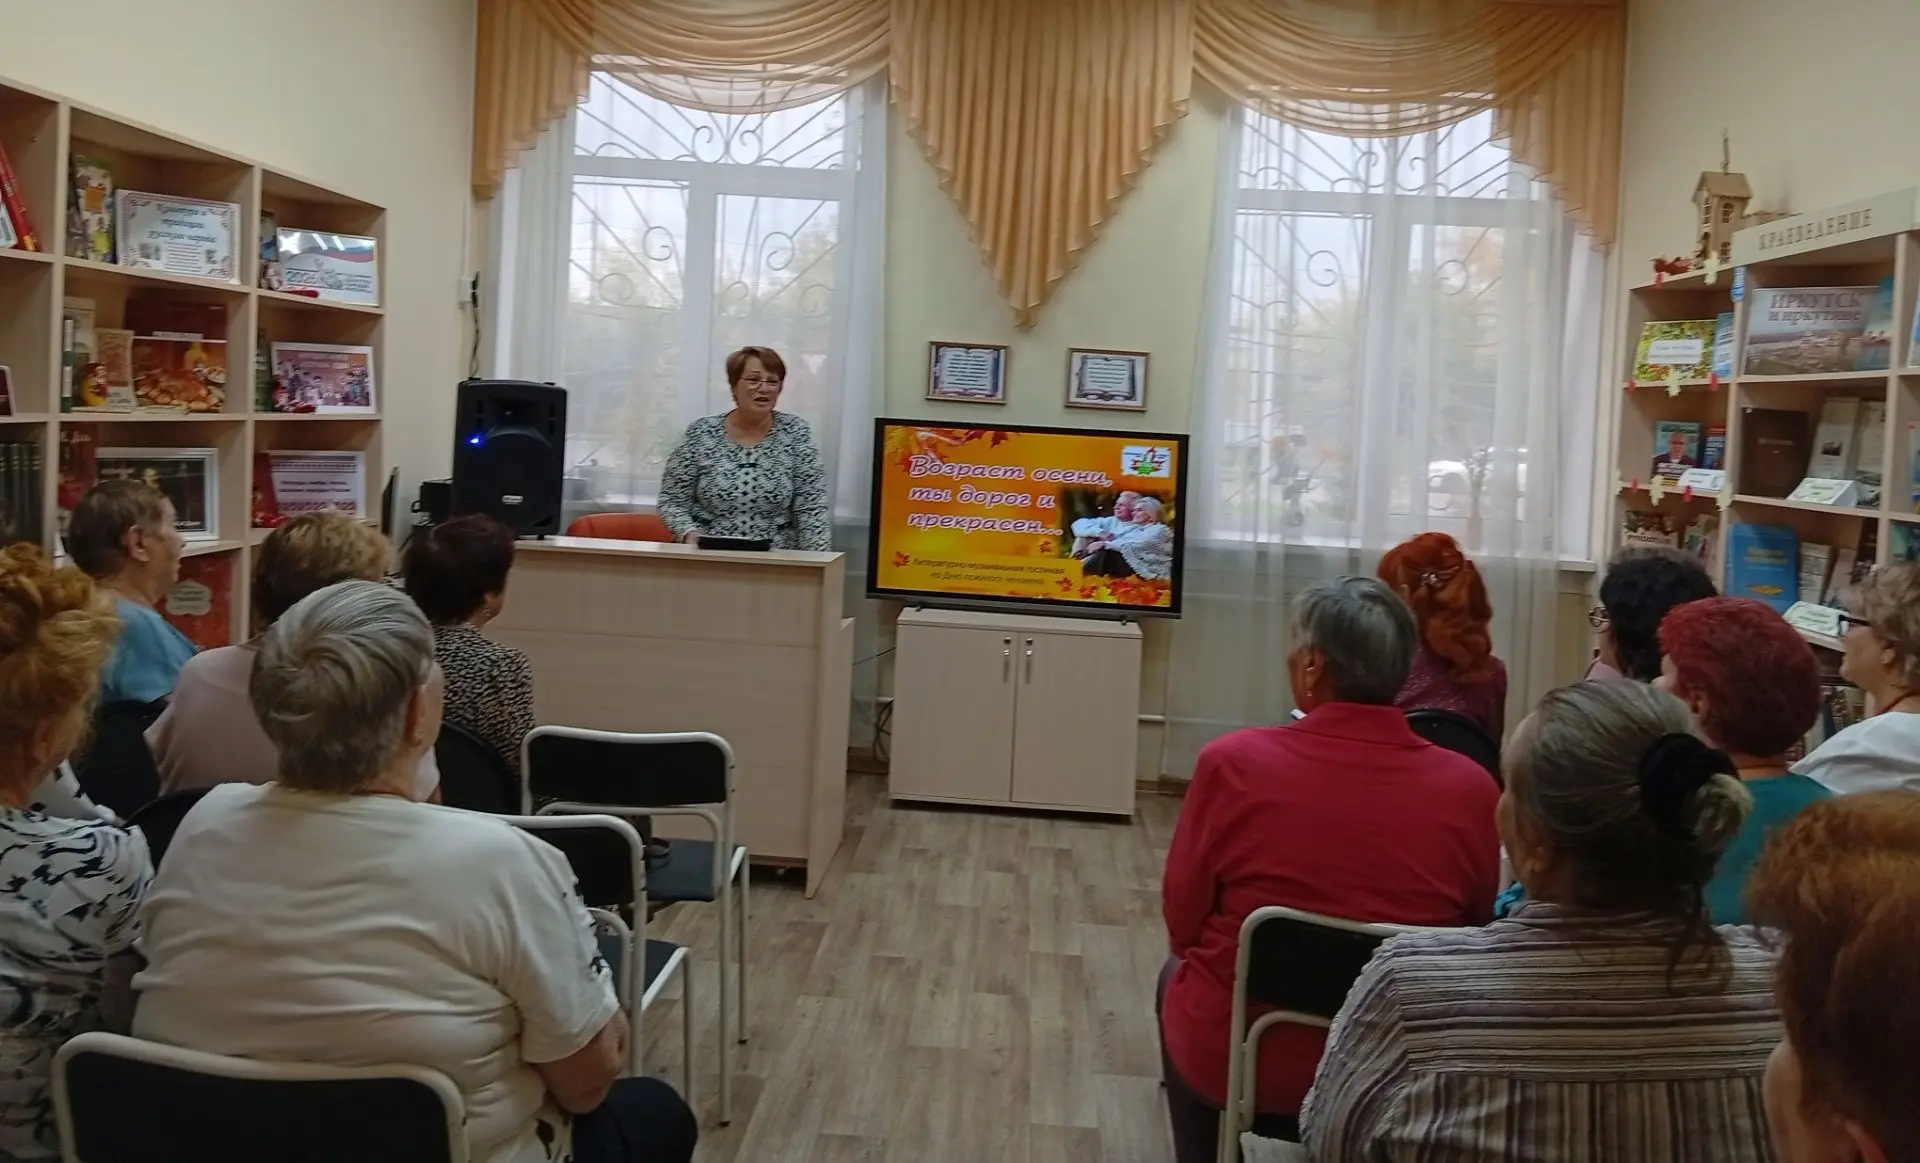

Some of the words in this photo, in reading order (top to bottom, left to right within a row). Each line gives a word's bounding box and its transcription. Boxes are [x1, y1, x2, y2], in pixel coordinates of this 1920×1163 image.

[1758, 208, 1872, 251] КРАЕВЕДЕНИЕ
[1770, 293, 1864, 308] ИРКУТСК
[908, 454, 1025, 480] Возраст
[1031, 466, 1113, 488] осени,
[908, 486, 952, 503] ты
[956, 485, 1031, 508] дорог
[1036, 494, 1056, 508] и
